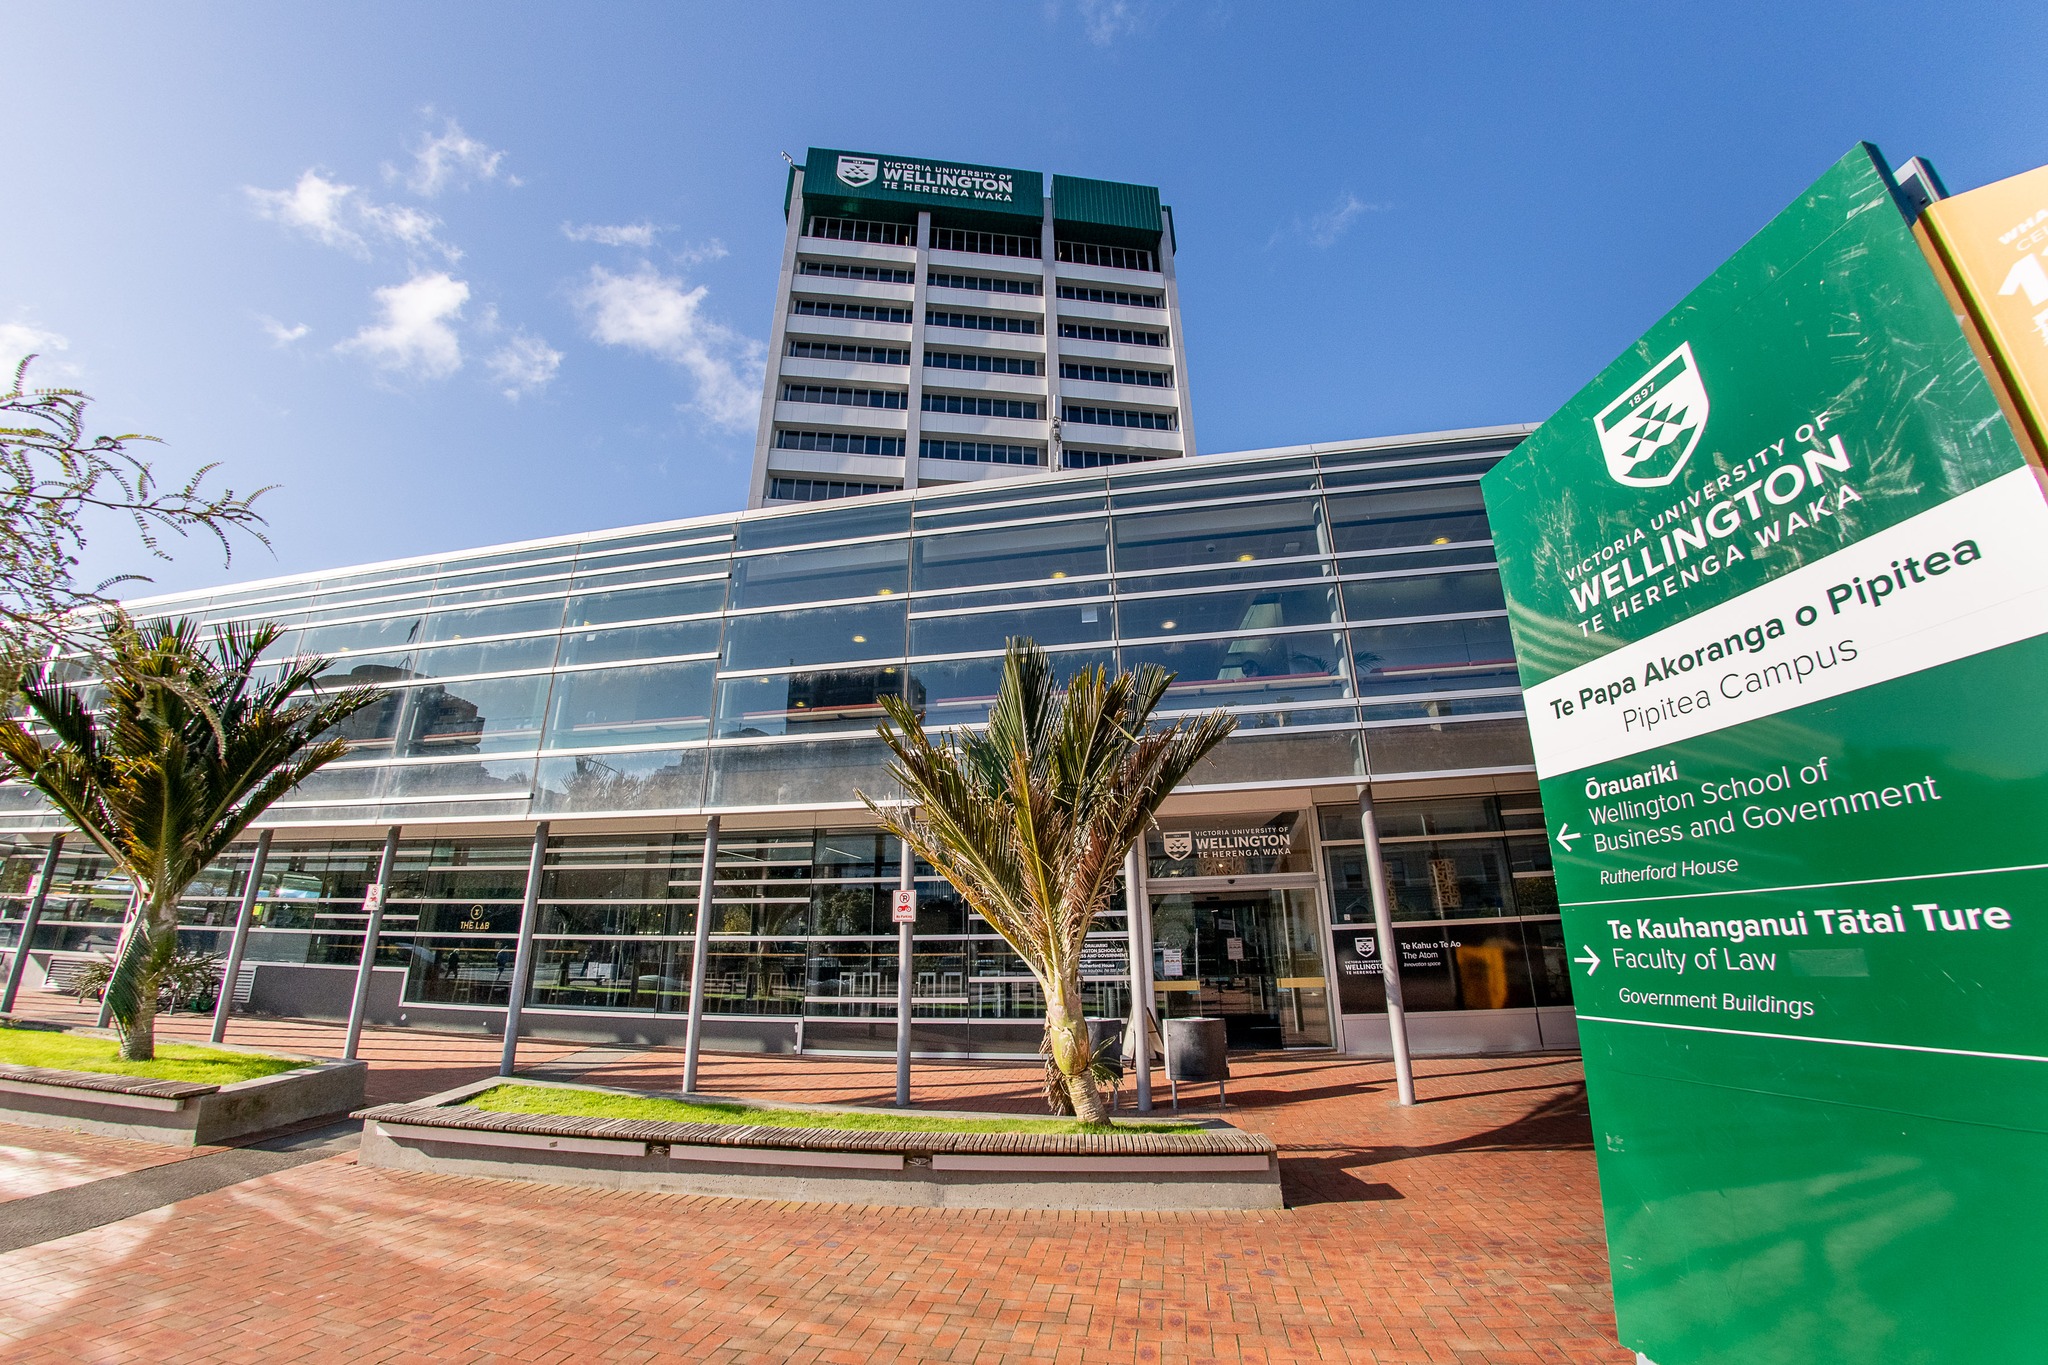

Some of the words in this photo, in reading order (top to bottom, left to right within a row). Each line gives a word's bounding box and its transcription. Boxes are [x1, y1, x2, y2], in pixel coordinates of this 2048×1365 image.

[883, 161, 932, 172] VICTORIA
[935, 166, 996, 179] UNIVERSITY
[998, 174, 1013, 182] OF
[883, 167, 1013, 193] WELLINGTON
[883, 180, 898, 190] TE
[903, 183, 969, 197] HERENGA
[974, 191, 1012, 202] WAKA
[1628, 382, 1655, 408] 1897
[1565, 527, 1646, 582] VICTORIA
[1651, 438, 1787, 531] UNIVERSITY
[1794, 410, 1832, 443] OF
[1568, 433, 1852, 614] WELLINGTON
[1578, 615, 1605, 638] TE
[1612, 544, 1745, 622] HERENGA
[1754, 484, 1863, 549] WAKA
[1549, 699, 1575, 721] Te
[1578, 673, 1638, 711] Papa
[1644, 616, 1786, 688] Akoranga
[1795, 604, 1818, 627] o
[1825, 538, 1982, 616] Pipitea
[1621, 688, 1712, 734] Pipitea
[1719, 638, 1860, 699] Campus
[1584, 760, 1679, 800] Ōrauariki
[1588, 790, 1695, 827] Wellington
[1700, 768, 1792, 805] School
[1800, 756, 1829, 785] of
[1593, 821, 1684, 854] Business
[1690, 806, 1736, 839] and
[1742, 774, 1943, 831] Government
[1195, 834, 1291, 850] WELLINGTON
[1231, 826, 1277, 835] UNIVERSITY
[1197, 851, 1208, 859] TE
[1212, 849, 1260, 858] HERENGA
[1262, 847, 1292, 856] WAKA
[1599, 862, 1677, 886] Rutherford
[1681, 855, 1739, 877] House
[460, 921, 474, 930] THE
[475, 921, 490, 930] LAB
[1607, 919, 1633, 940] Te
[1637, 910, 1809, 944] Kauhanganui
[1814, 905, 1907, 936] Tātai
[1912, 903, 2013, 932] Ture
[1401, 942, 1411, 950] Te
[1411, 942, 1432, 950] Kahu
[1439, 940, 1449, 948] Te
[1450, 940, 1462, 948] Ao
[1402, 951, 1418, 960] The
[1419, 951, 1439, 959] Atom
[1612, 948, 1686, 976] Faculty
[1694, 946, 1718, 971] of
[1723, 947, 1777, 972] Law
[1618, 987, 1718, 1010] Government
[1722, 993, 1815, 1020] Buildings
